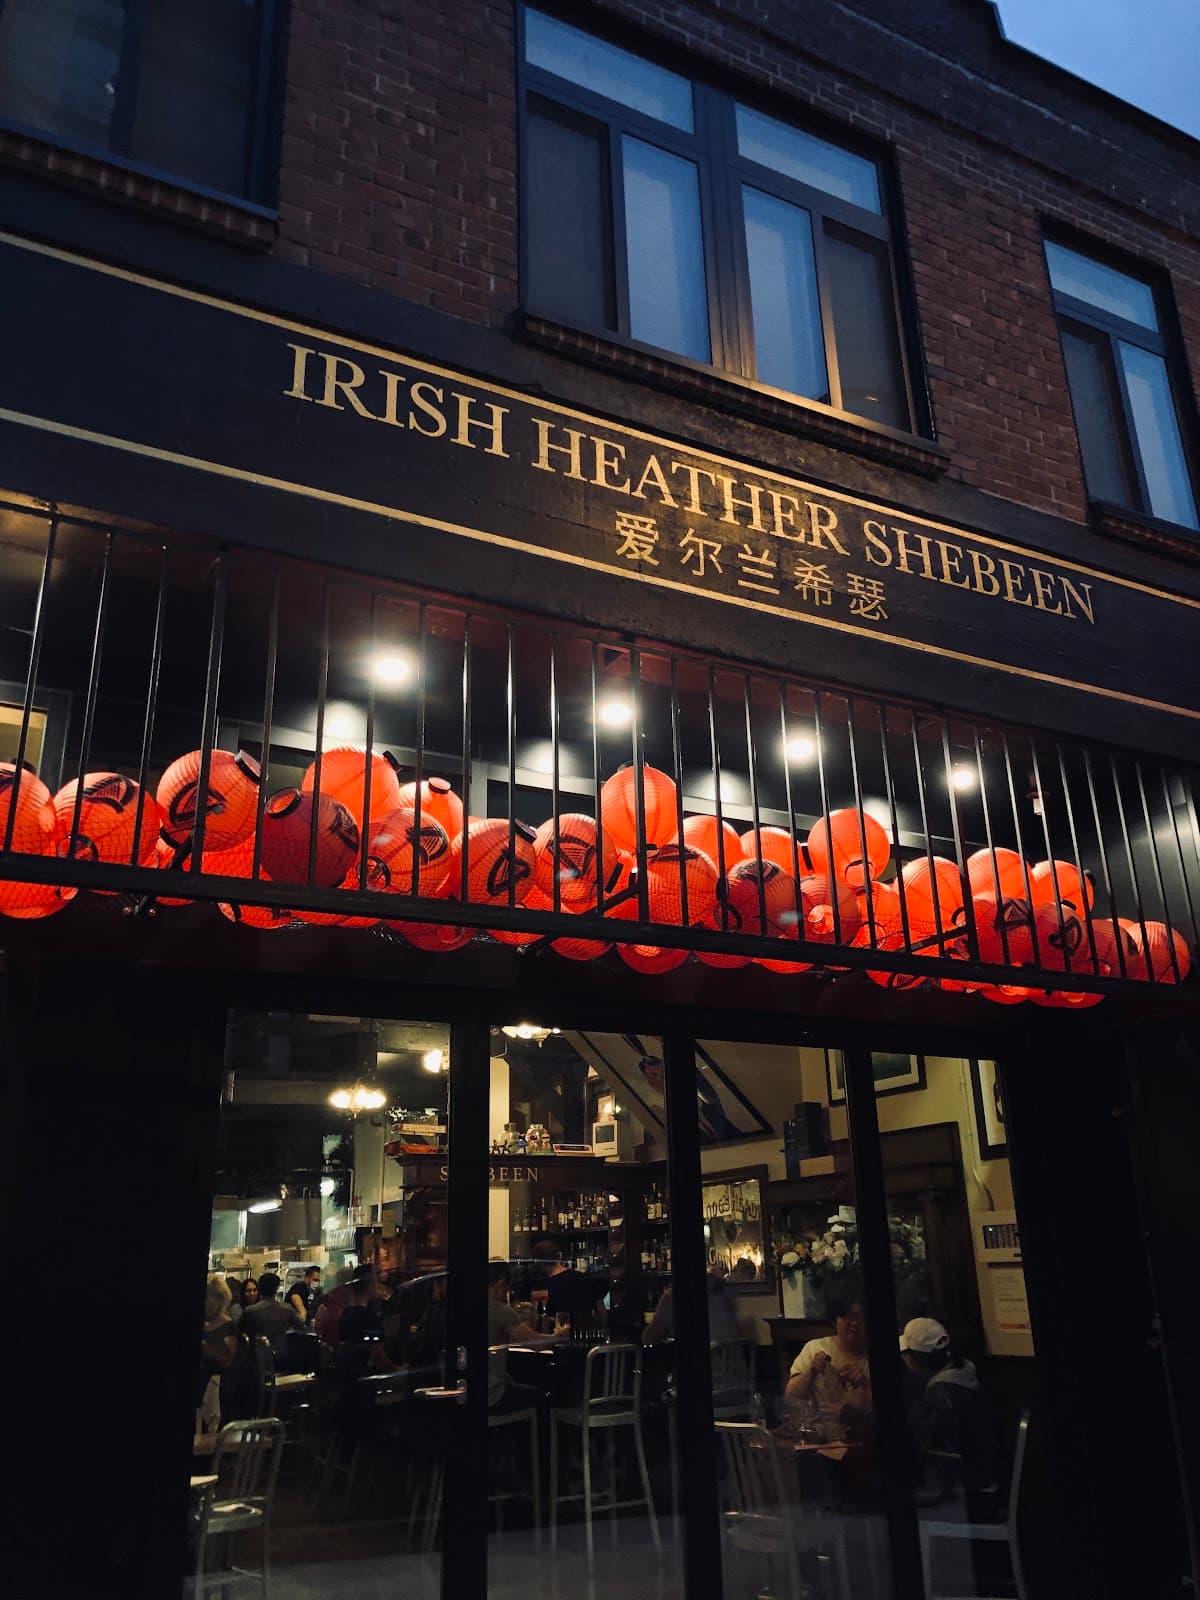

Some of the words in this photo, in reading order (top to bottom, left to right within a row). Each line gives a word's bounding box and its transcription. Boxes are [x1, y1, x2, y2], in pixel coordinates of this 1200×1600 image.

[283, 342, 510, 459] IRISH
[531, 417, 849, 557] HEATHER
[863, 520, 1096, 625] SHEBEEN
[615, 510, 889, 622] 爱尔兰希瑟
[440, 1165, 539, 1183] SBEEN
